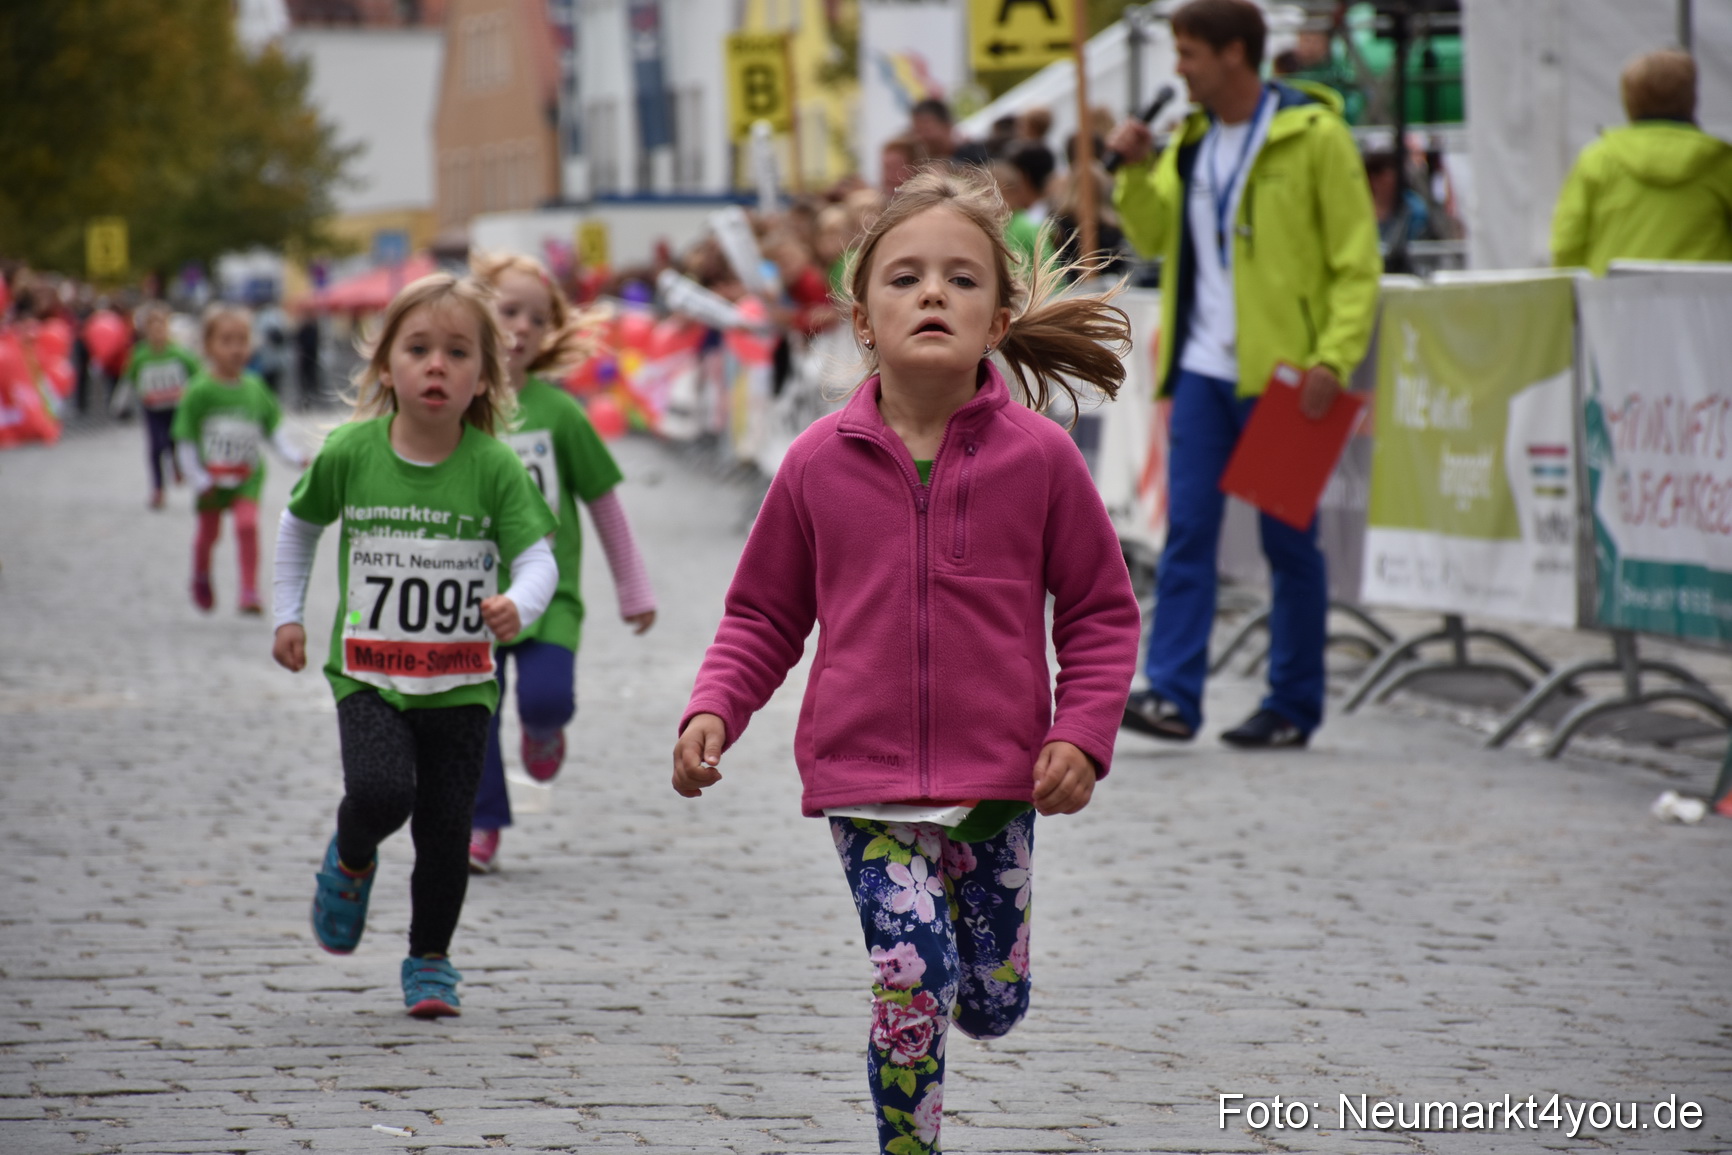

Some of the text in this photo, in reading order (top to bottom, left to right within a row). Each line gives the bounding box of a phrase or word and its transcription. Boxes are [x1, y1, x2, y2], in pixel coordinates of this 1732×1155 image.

[353, 552, 479, 570] PARTL Neumarkt
[365, 576, 484, 634] 7095
